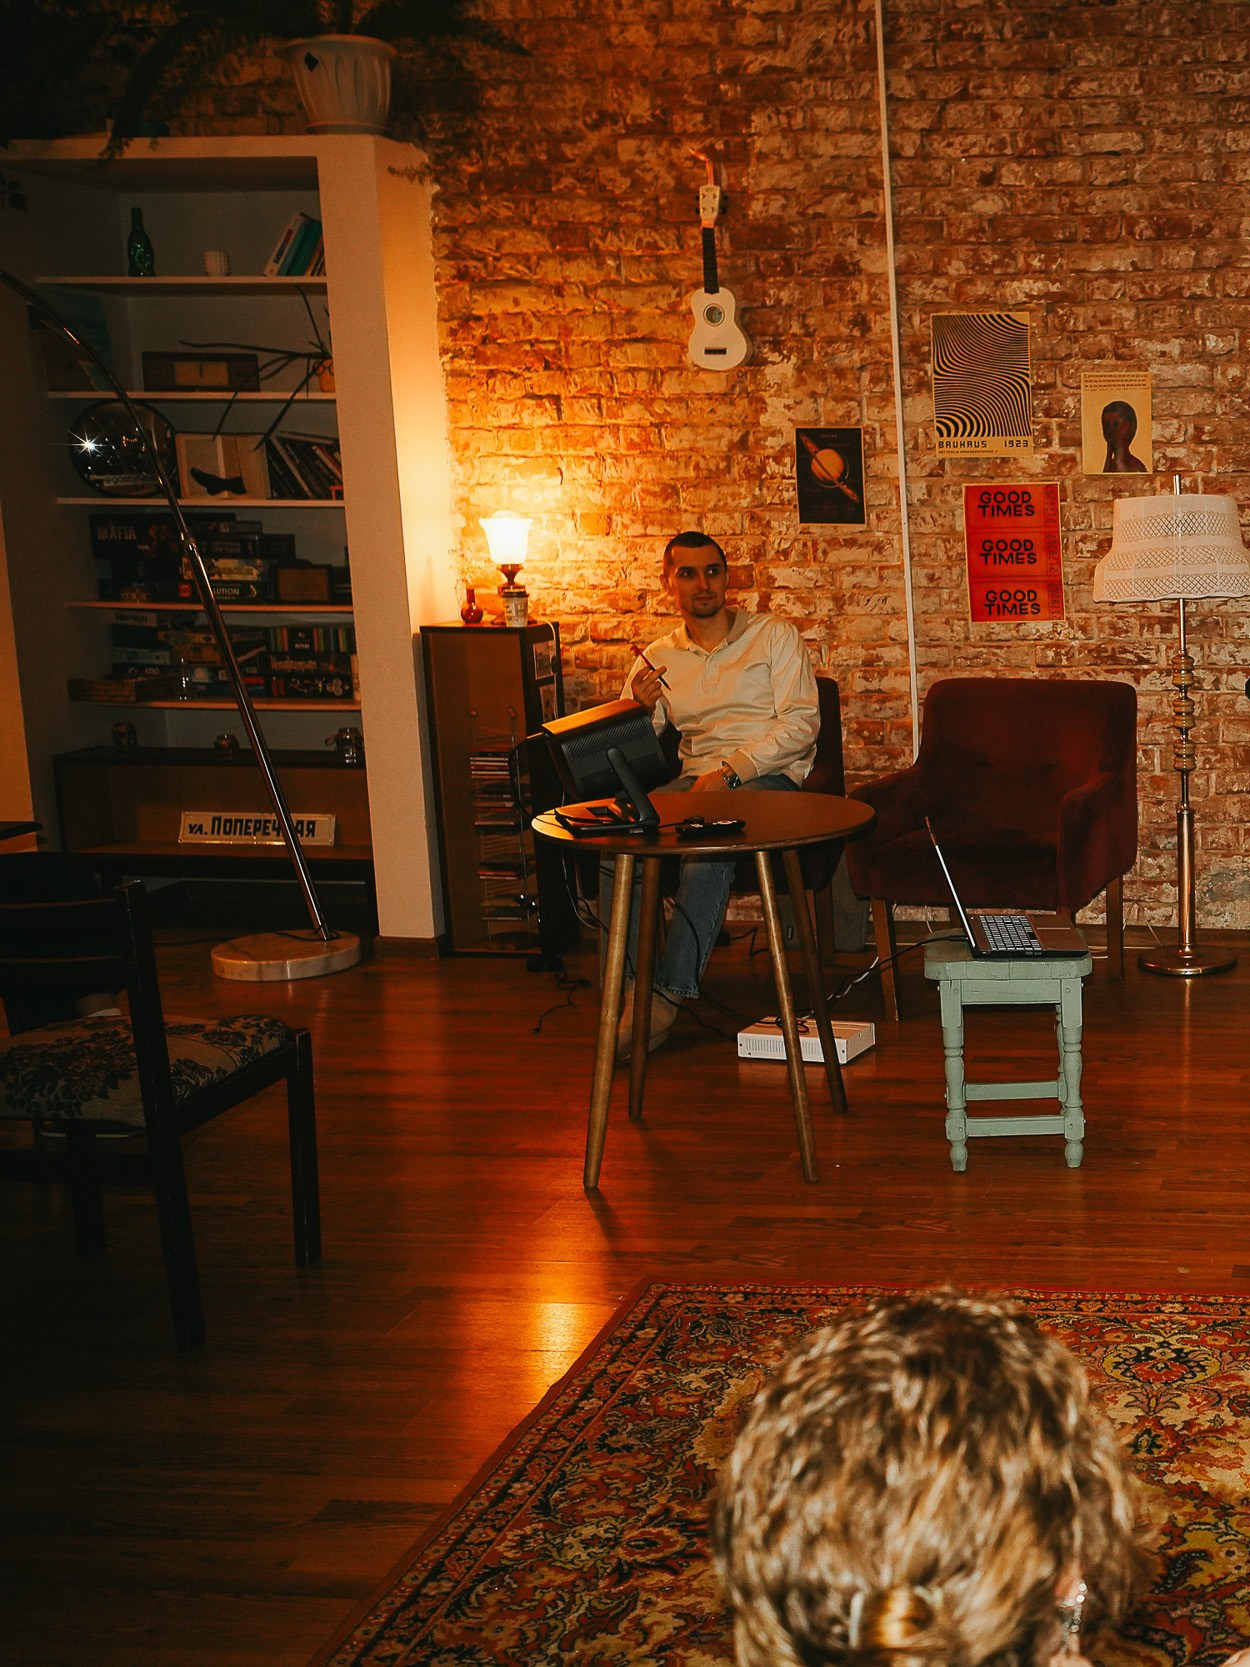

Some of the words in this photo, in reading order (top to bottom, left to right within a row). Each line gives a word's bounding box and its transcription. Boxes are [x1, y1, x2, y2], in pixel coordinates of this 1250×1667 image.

[938, 440, 987, 448] BAUHAUS
[1004, 439, 1029, 448] 1923
[979, 491, 1032, 504] GOOD
[977, 504, 1035, 517] TIMES
[981, 539, 1034, 552] GOOD
[979, 552, 1037, 565] TIMES
[985, 589, 1038, 603] GOOD
[983, 603, 1041, 616] TIMES
[211, 815, 316, 838] ПОПЕРЕЧАЯ
